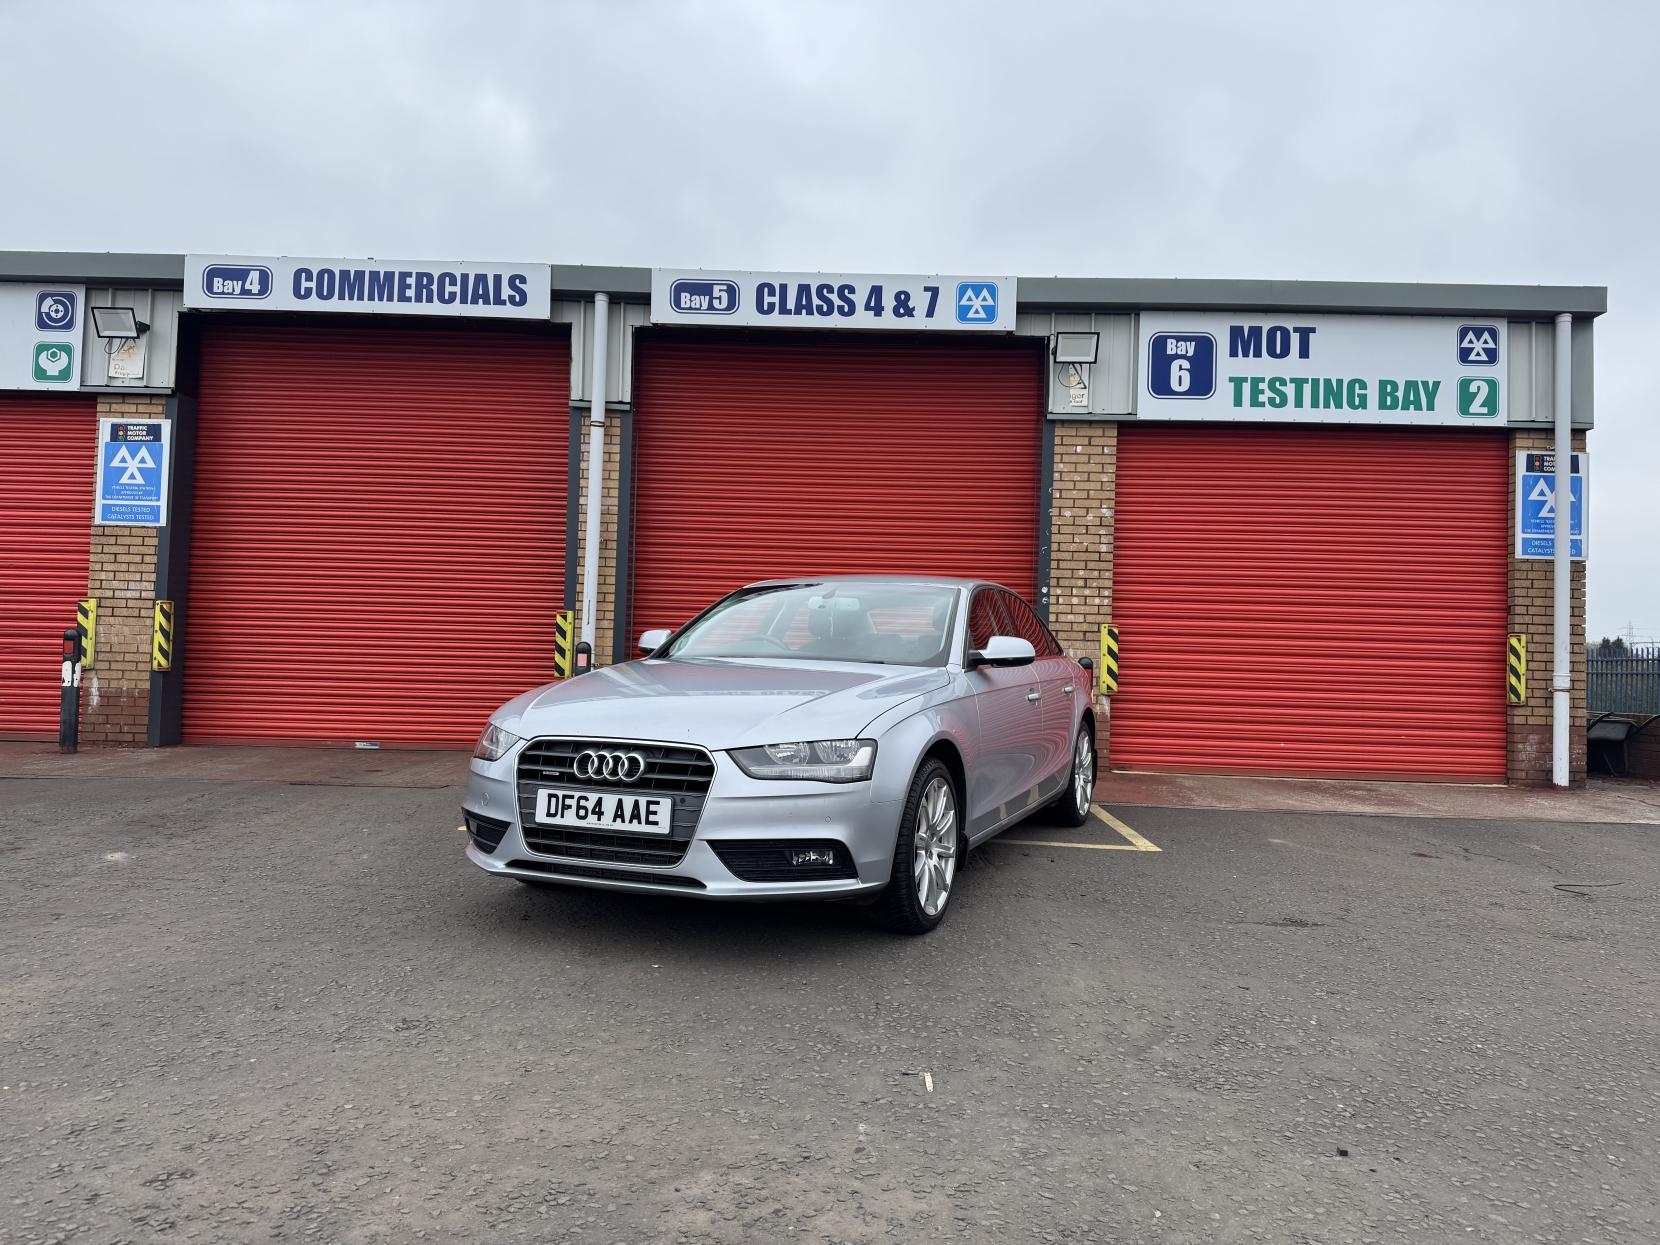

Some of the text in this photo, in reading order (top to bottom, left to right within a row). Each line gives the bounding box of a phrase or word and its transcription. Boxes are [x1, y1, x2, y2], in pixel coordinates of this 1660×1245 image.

[213, 270, 261, 295] Bay 4
[292, 267, 528, 307] COMMERCIALS
[680, 284, 729, 310] Bay 5
[755, 282, 940, 318] CLASS 4 & 7
[1166, 338, 1196, 357] Bay
[1229, 325, 1317, 359] MOT
[1170, 359, 1191, 392] 6
[1228, 376, 1442, 412] TESTING BAY
[1469, 380, 1489, 413] 2
[546, 793, 661, 826] DF64 AAE
